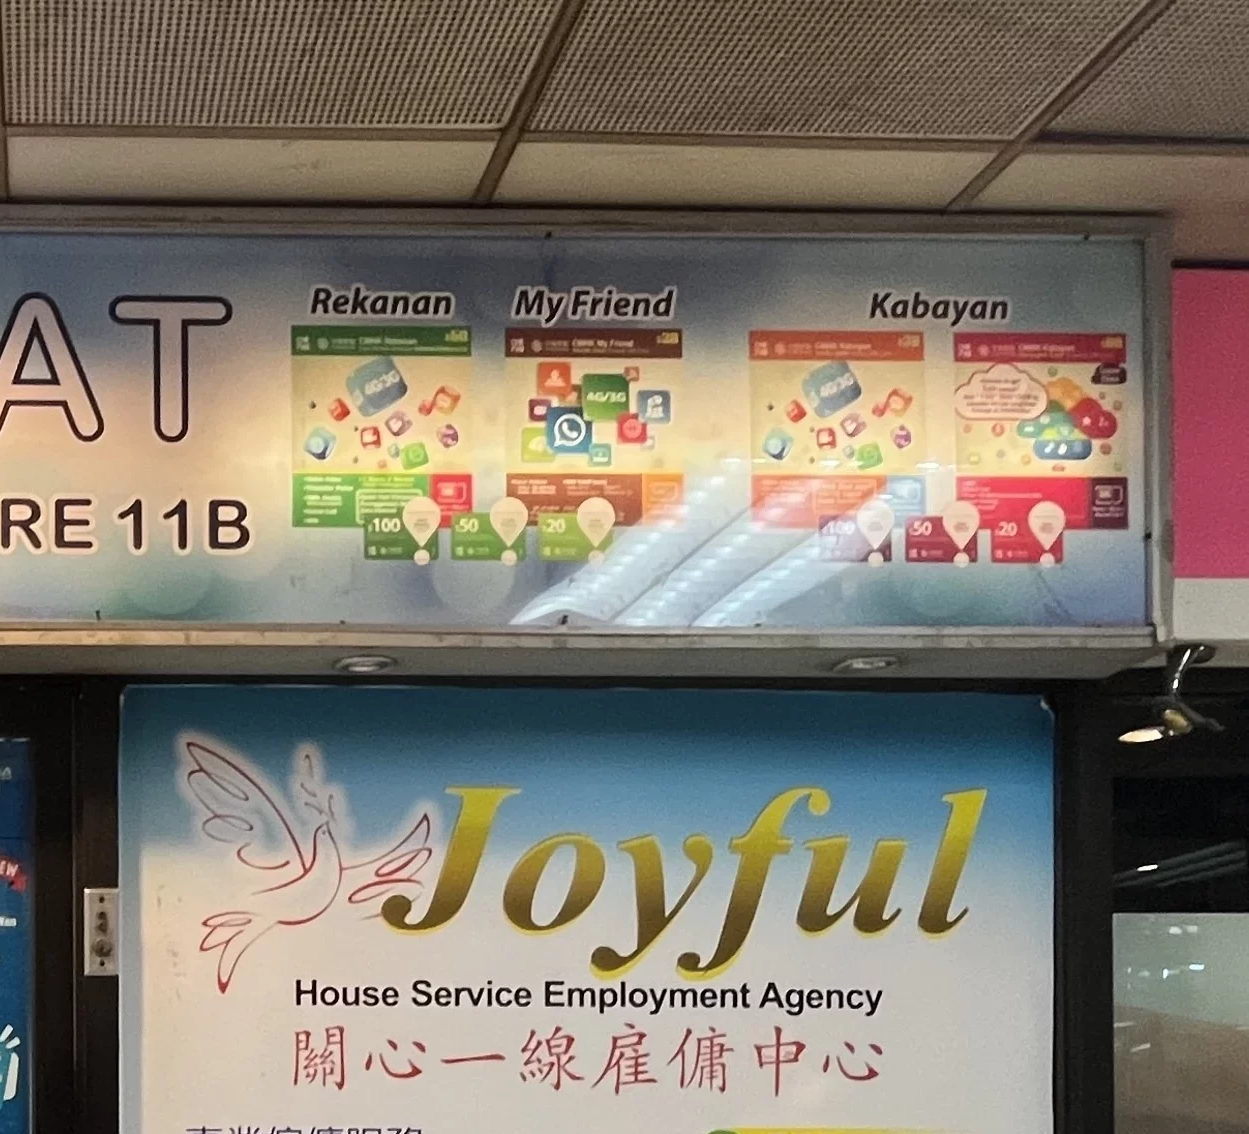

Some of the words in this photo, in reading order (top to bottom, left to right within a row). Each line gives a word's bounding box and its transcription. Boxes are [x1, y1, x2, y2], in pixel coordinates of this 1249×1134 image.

[310, 287, 452, 316] Rekanan
[515, 289, 563, 324] My
[570, 289, 674, 318] Friend
[869, 292, 1008, 326] Kabayan
[118, 498, 250, 550] 11B
[380, 785, 987, 981] Joyful
[295, 978, 399, 1008] House
[411, 979, 532, 1008] Service
[544, 980, 749, 1016] Employment
[759, 981, 883, 1017] Agency
[293, 1022, 884, 1097] 關心一線雇傭中心
